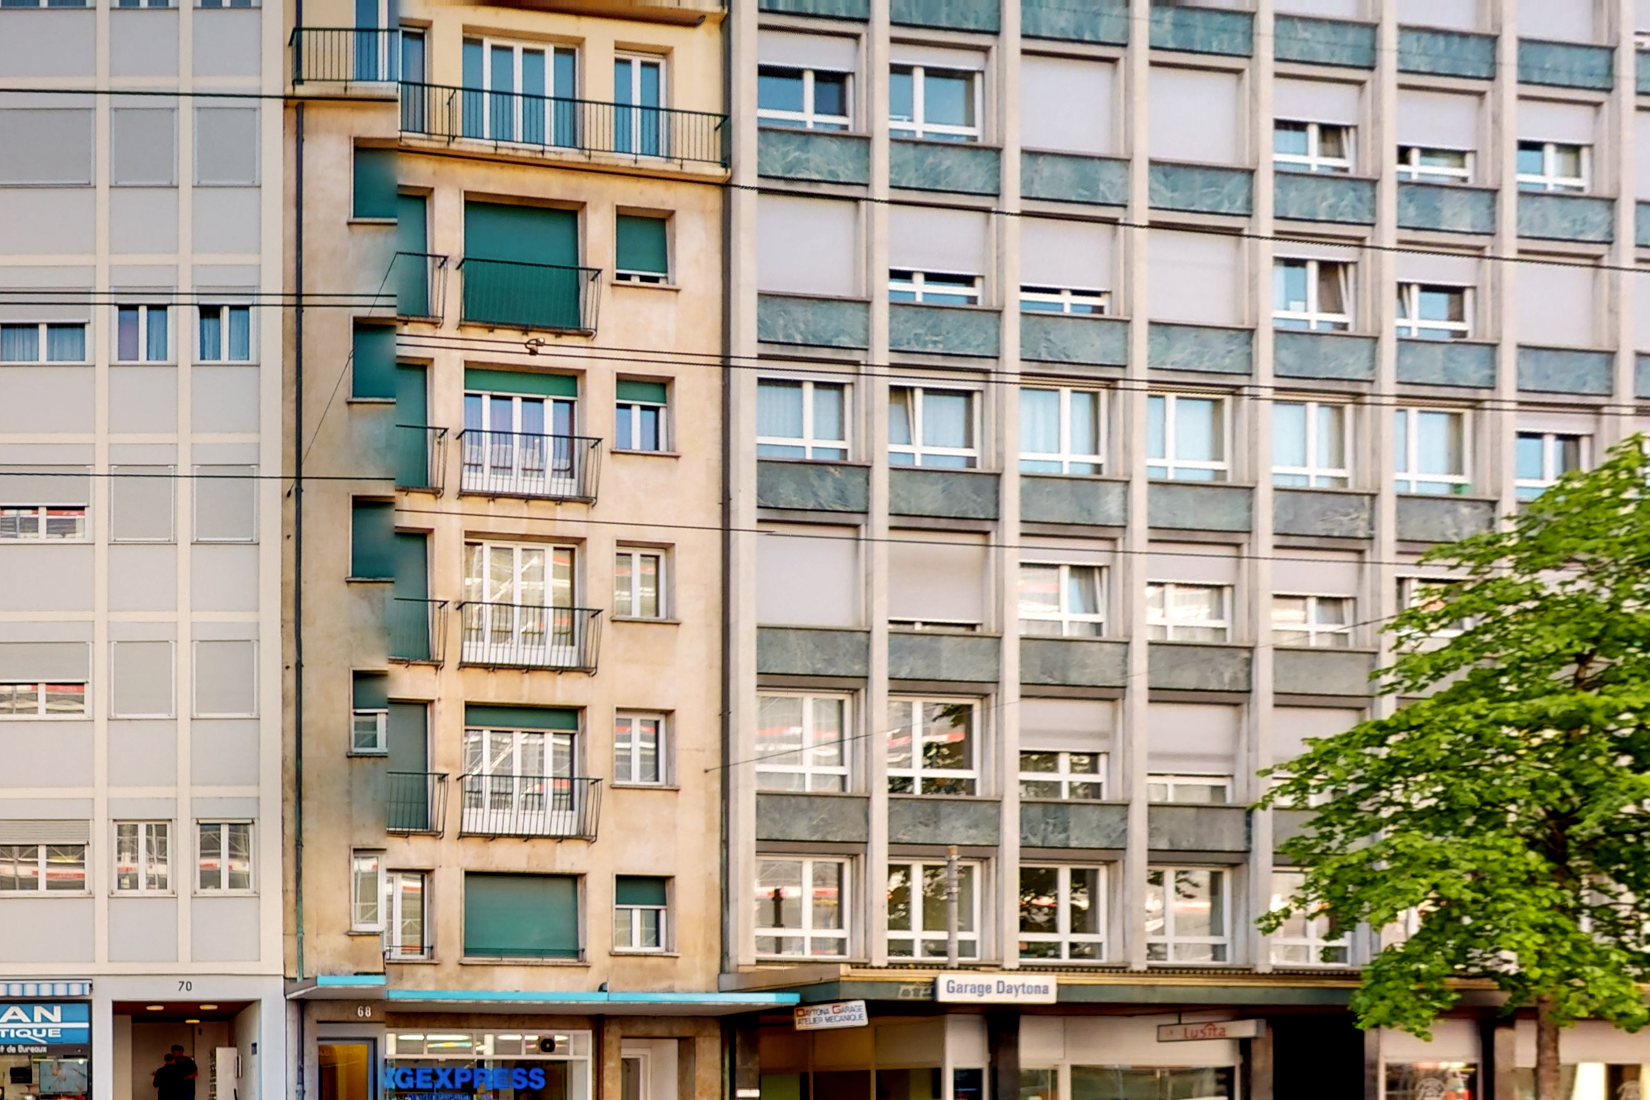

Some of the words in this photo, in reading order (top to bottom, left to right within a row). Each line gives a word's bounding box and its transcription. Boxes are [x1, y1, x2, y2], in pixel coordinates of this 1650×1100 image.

[178, 981, 193, 992] 70
[946, 979, 992, 997] Garage
[996, 981, 1050, 998] Daytona
[357, 1006, 372, 1017] 68
[797, 1016, 824, 1025] ATELIER
[6, 1045, 16, 1054] de
[17, 1045, 48, 1054] Bureaux
